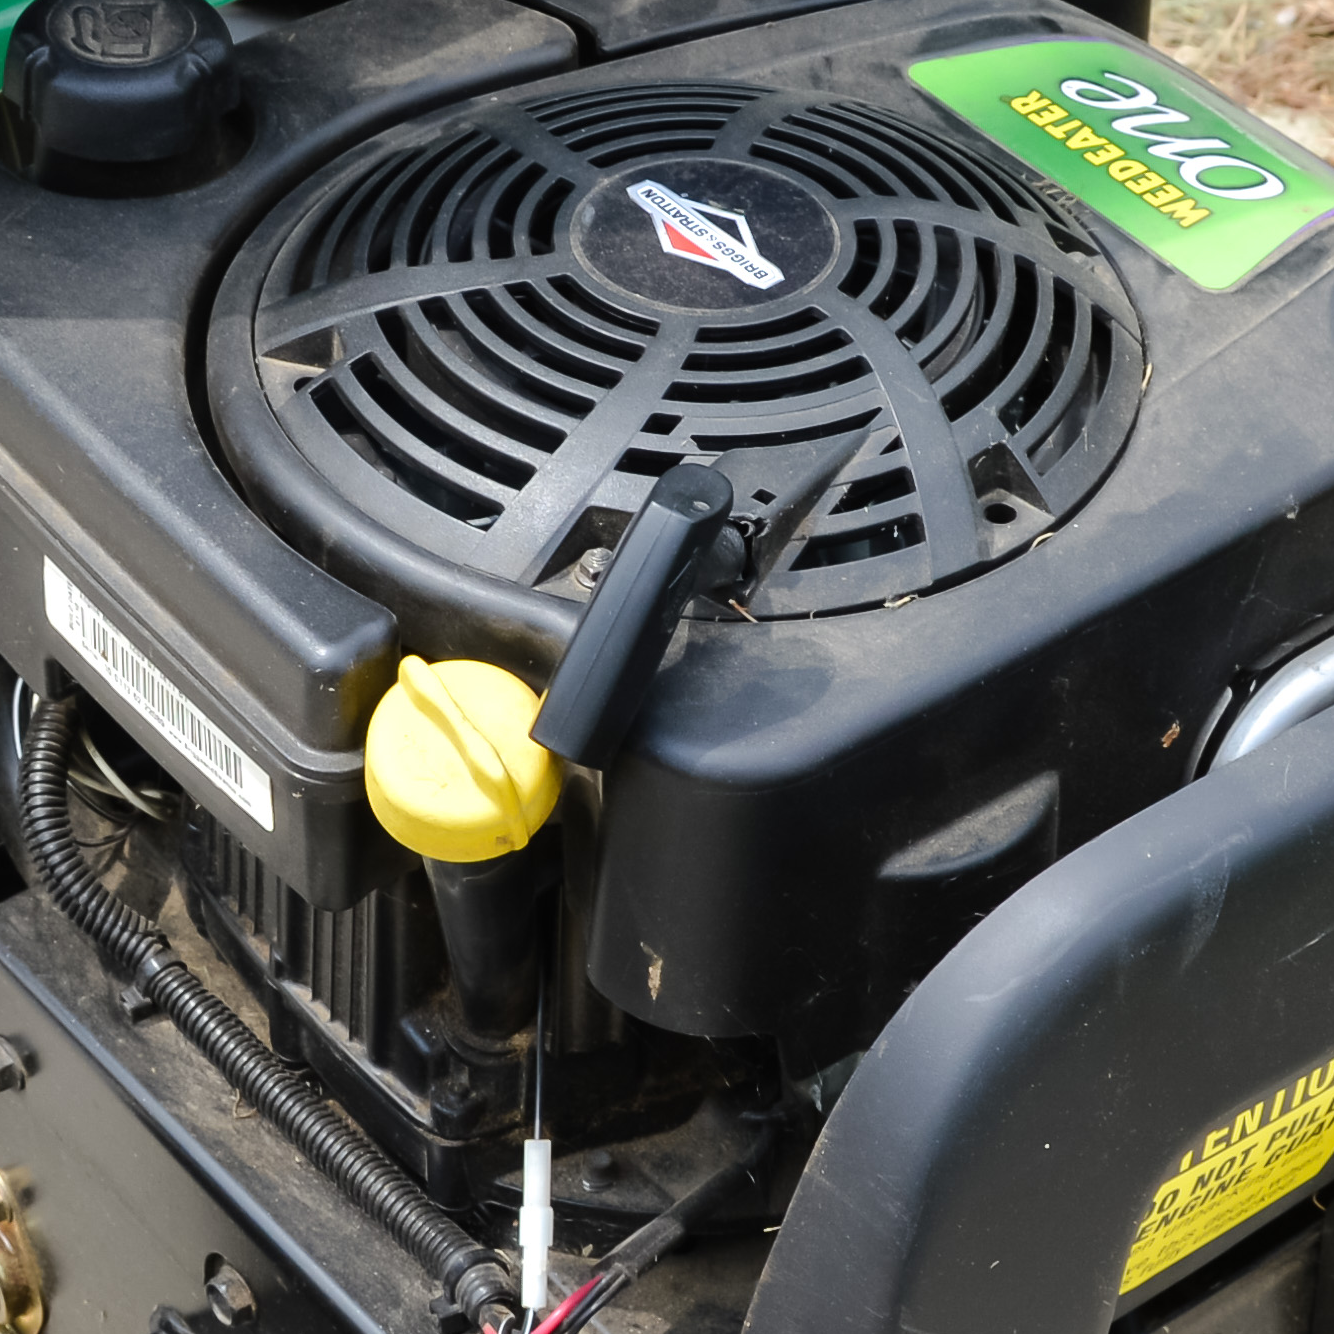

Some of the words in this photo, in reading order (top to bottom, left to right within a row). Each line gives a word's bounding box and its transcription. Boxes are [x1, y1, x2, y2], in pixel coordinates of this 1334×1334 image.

[1010, 89, 1212, 228] WEEDEATER
[1060, 72, 1285, 200] one
[641, 188, 708, 238] STRATTON
[712, 240, 769, 280] BRIGGS
[1135, 1162, 1258, 1242] ENGINE
[1191, 1143, 1259, 1196] NOT
